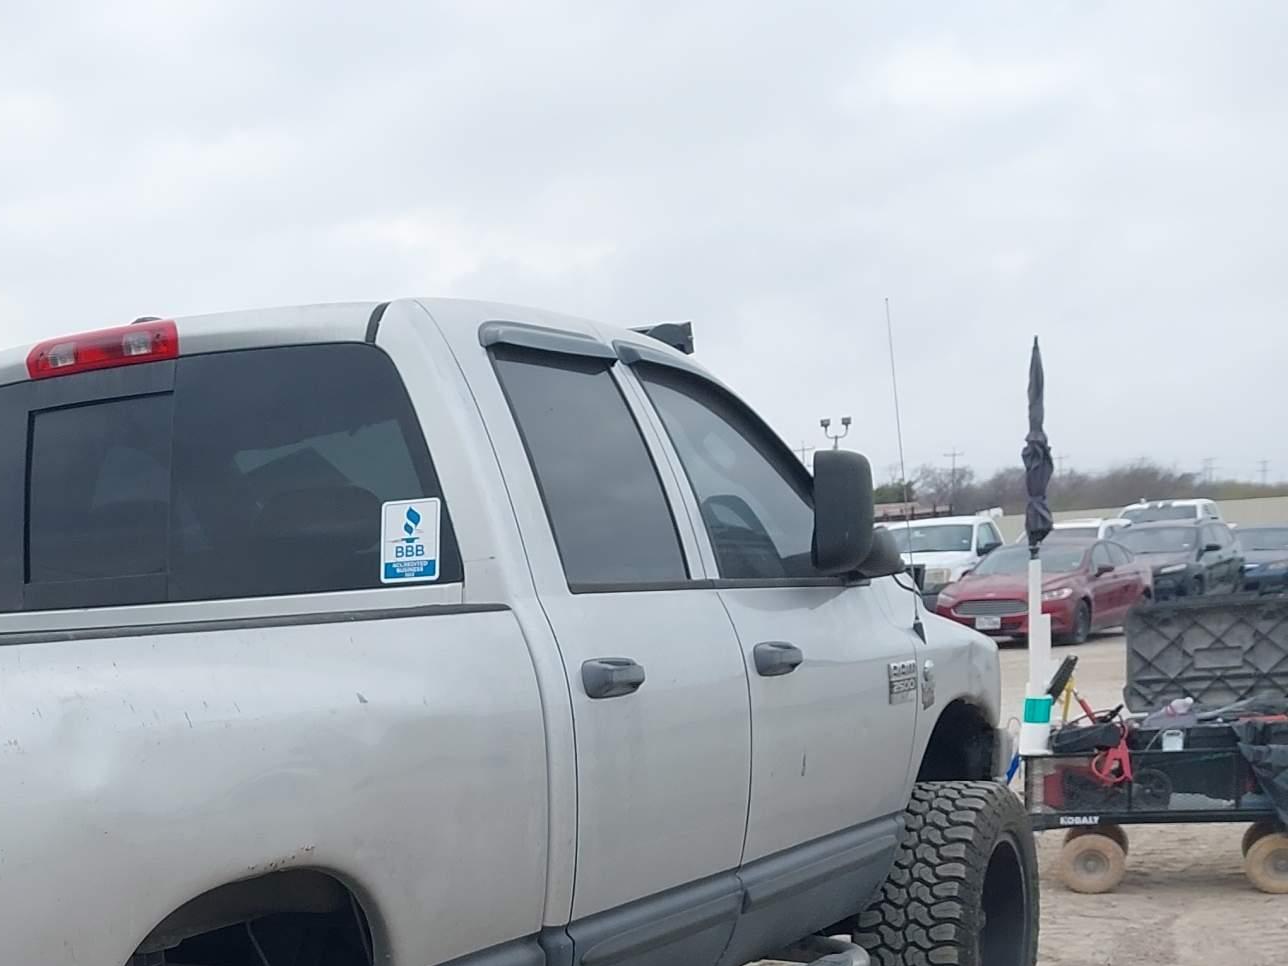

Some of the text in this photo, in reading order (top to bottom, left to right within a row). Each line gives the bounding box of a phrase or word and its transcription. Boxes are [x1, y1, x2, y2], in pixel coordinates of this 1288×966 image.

[395, 544, 425, 558] BBB
[890, 660, 916, 677] RAM
[892, 678, 915, 693] 2500
[1059, 815, 1100, 825] KOBALT
